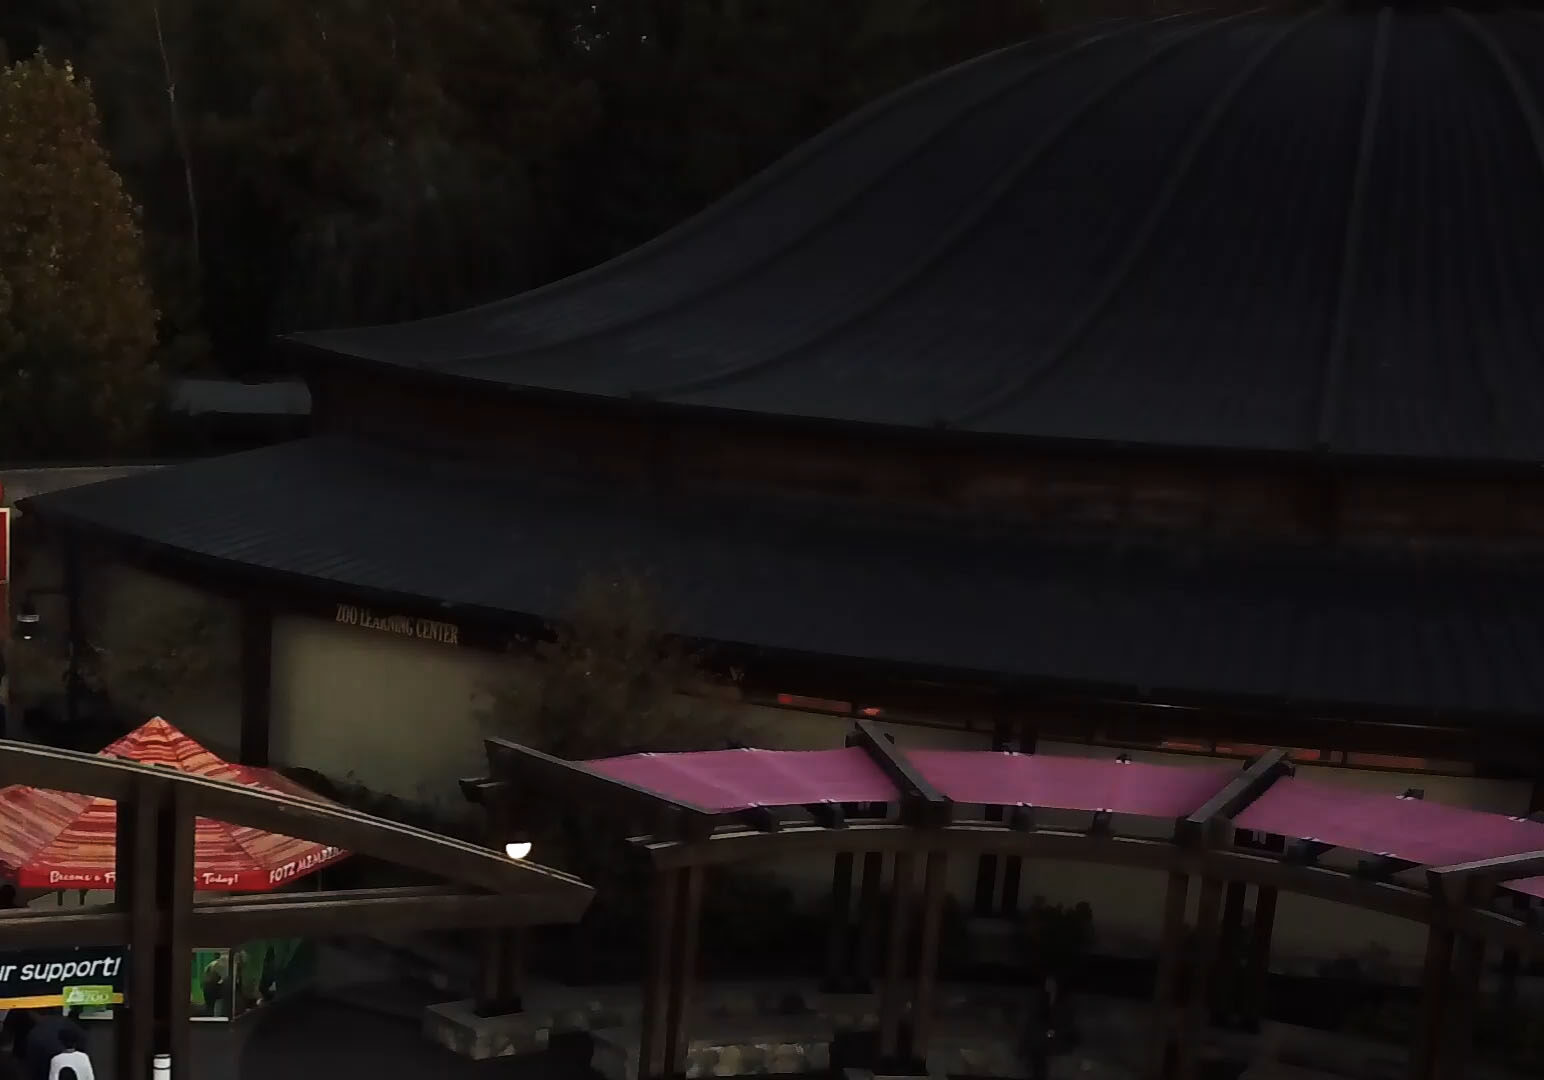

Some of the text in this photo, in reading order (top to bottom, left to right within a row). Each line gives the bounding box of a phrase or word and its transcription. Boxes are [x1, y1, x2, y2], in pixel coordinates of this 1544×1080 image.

[336, 602, 459, 644] ZOO LEARNING CENTER
[202, 872, 239, 886] Today!
[20, 956, 122, 983] support!
